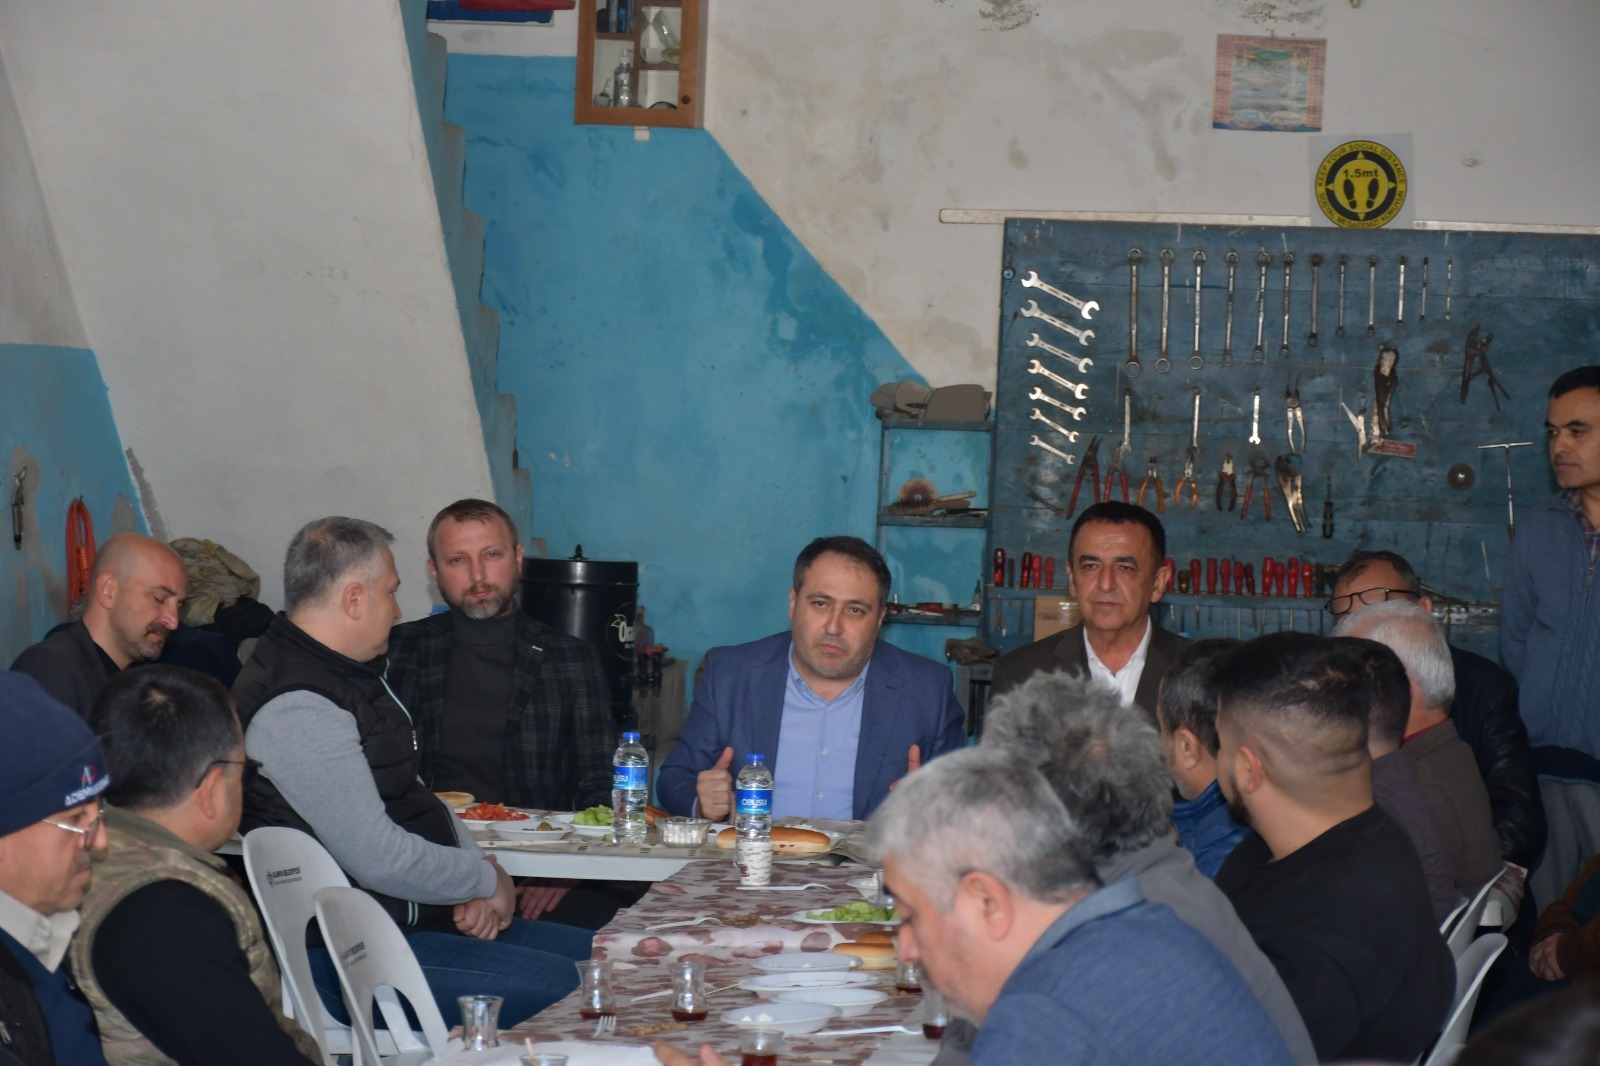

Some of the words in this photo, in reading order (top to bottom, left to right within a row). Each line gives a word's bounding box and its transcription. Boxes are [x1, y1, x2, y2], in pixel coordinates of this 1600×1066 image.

[1327, 147, 1347, 164] YOUR
[1349, 143, 1378, 153] SOCIAL
[1381, 148, 1405, 184] DISTANCE
[1343, 168, 1379, 178] 1.5mt
